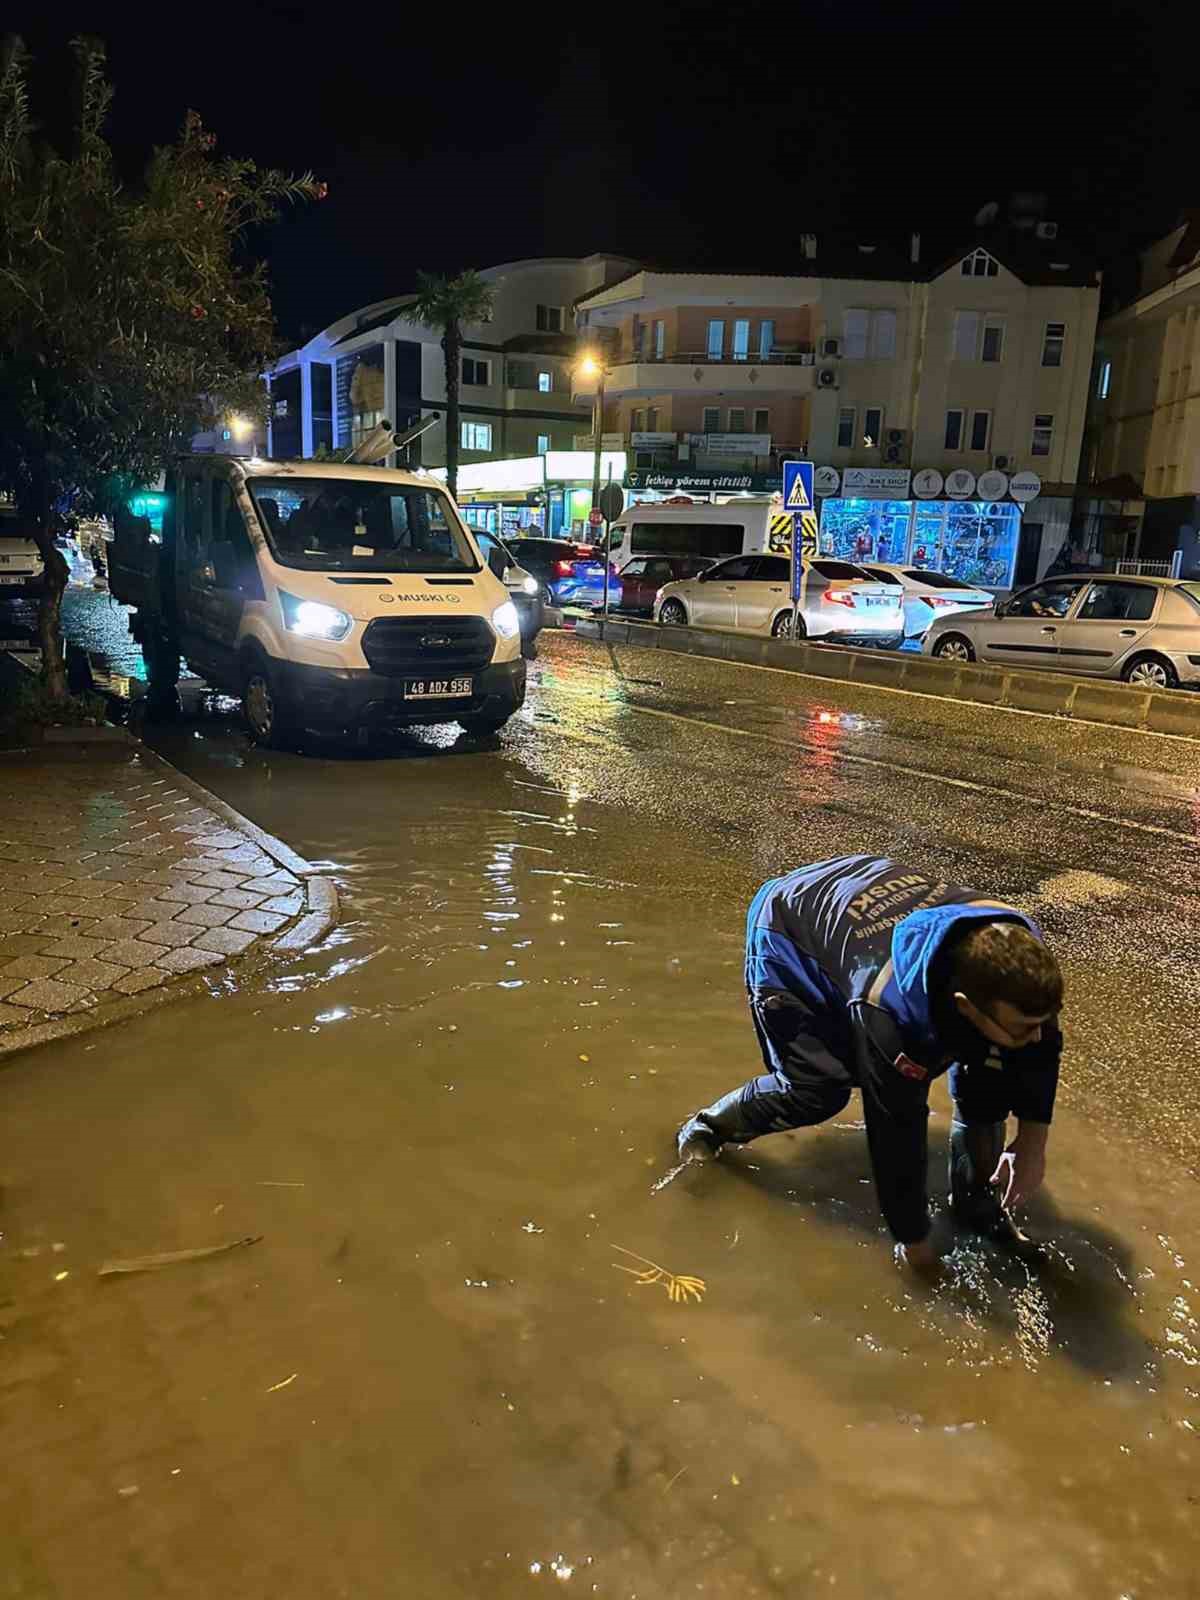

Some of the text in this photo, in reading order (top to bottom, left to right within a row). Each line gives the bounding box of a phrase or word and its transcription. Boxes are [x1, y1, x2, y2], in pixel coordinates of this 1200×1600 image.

[411, 680, 470, 694] 48 ADZ 956
